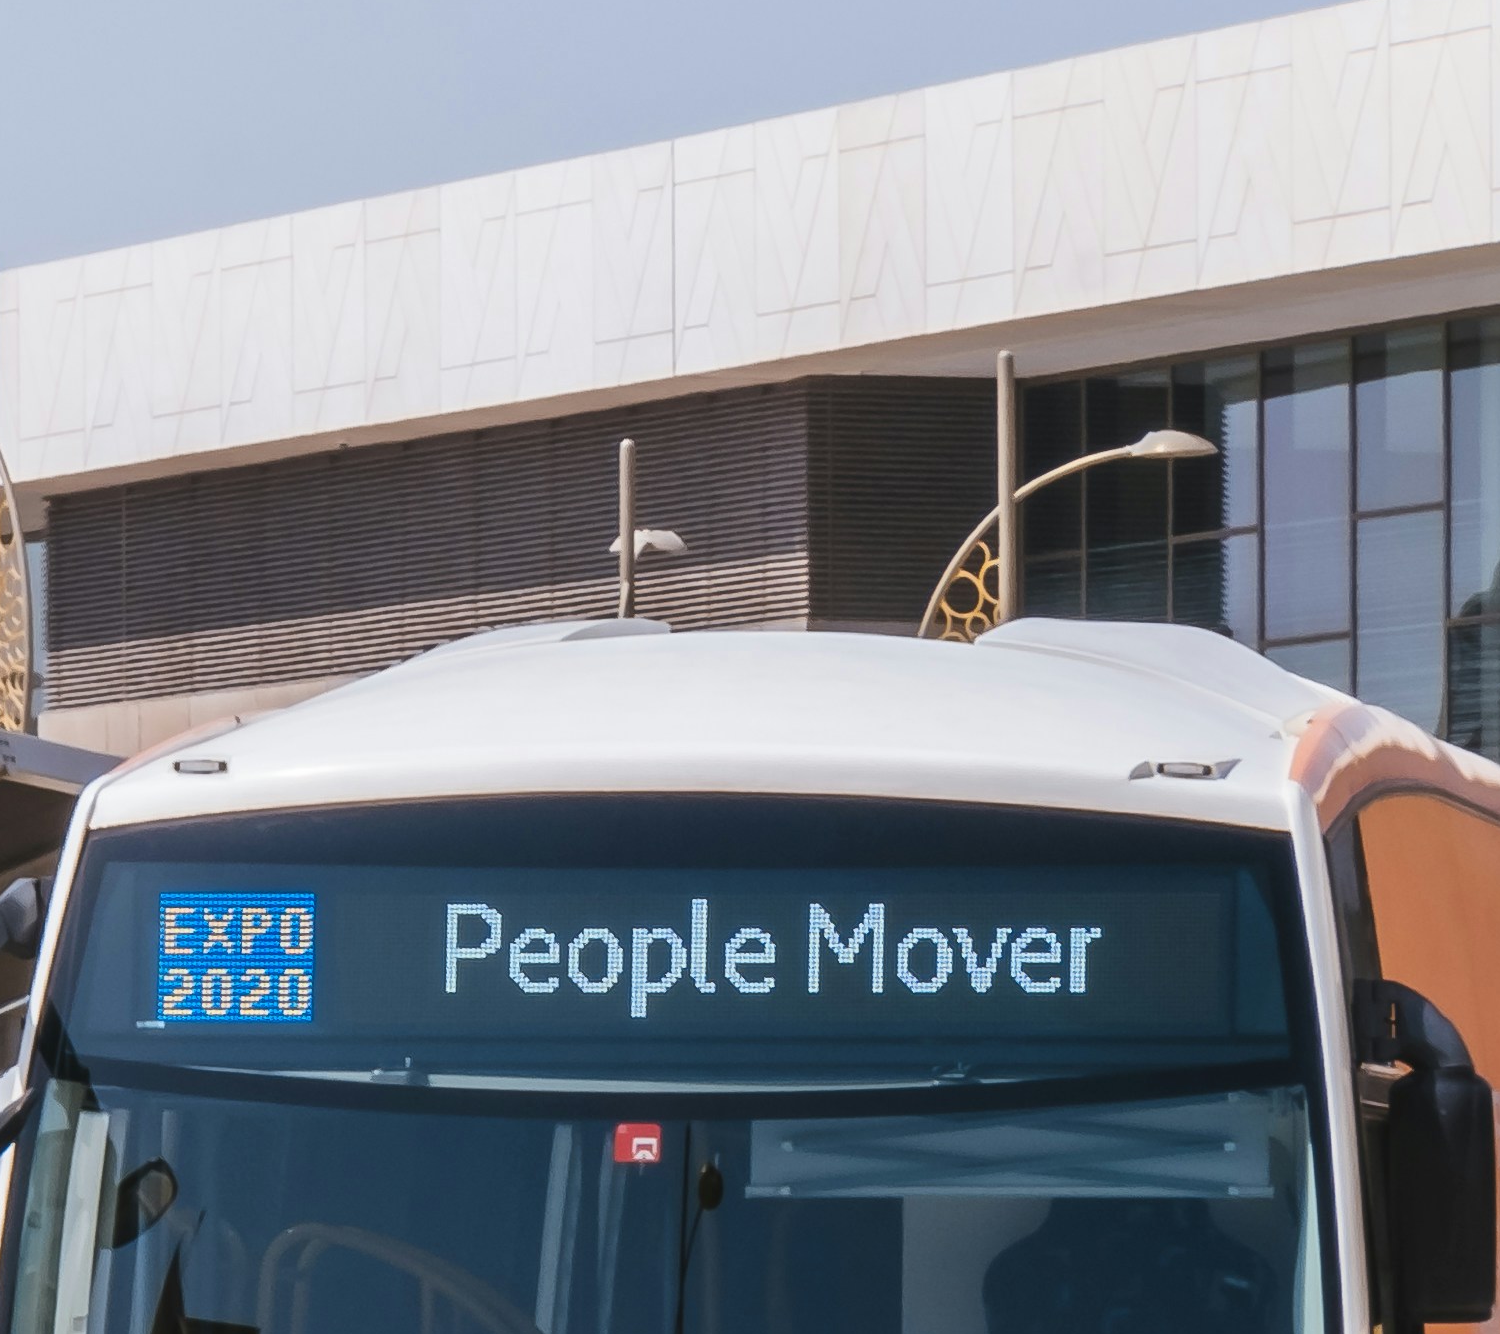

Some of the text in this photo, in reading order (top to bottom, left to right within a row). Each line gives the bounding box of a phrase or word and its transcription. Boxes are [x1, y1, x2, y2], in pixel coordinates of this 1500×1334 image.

[163, 906, 313, 955] EXPO
[445, 898, 1102, 1018] People Mover
[162, 968, 312, 1016] 2020
